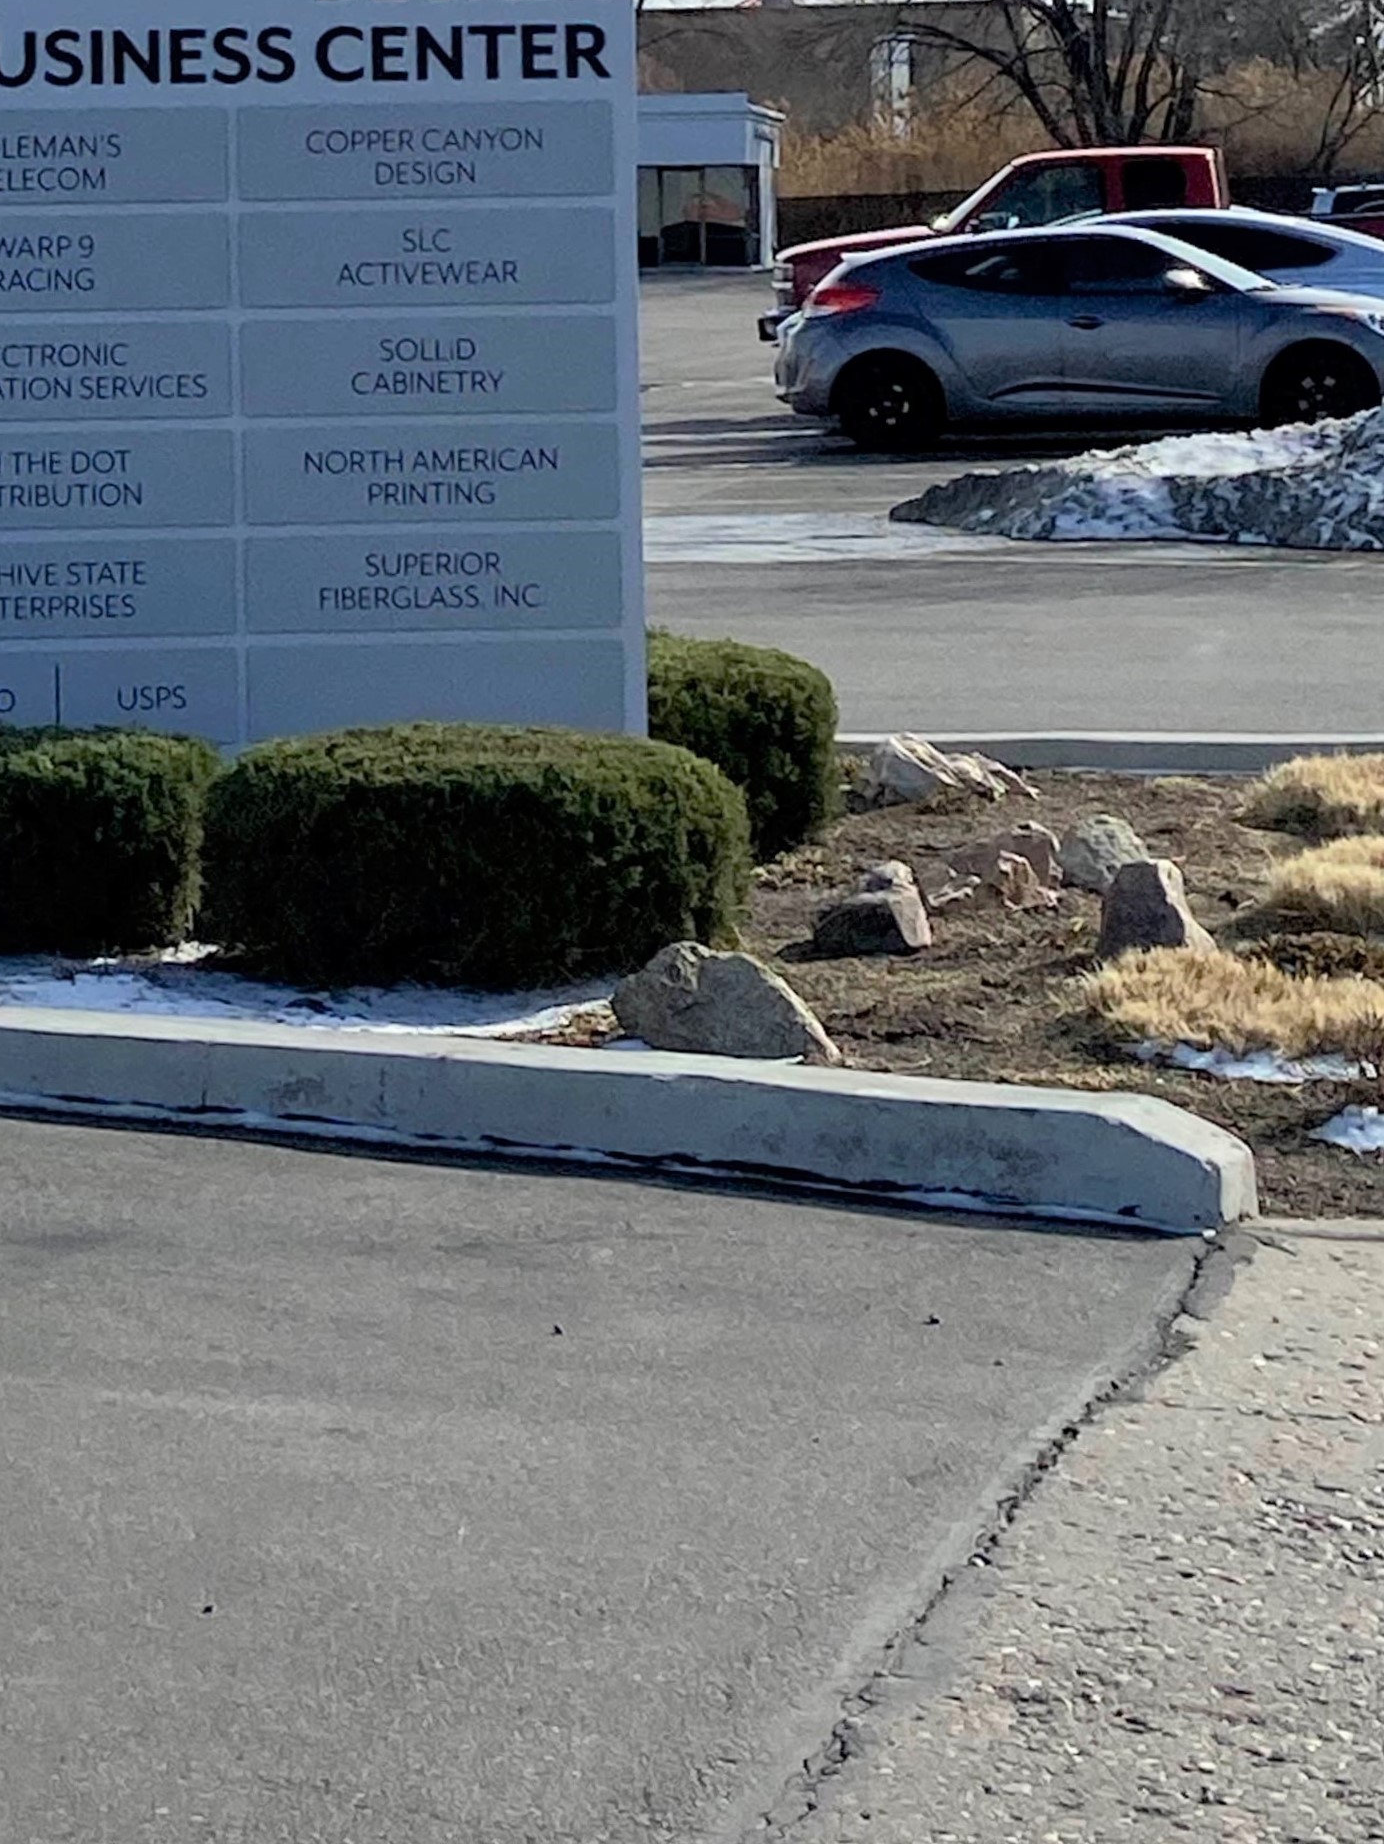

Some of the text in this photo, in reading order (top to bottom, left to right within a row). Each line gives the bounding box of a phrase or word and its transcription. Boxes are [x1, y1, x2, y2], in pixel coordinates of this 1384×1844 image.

[314, 23, 612, 83] CENTER
[305, 127, 543, 155] COPPER CANYON
[374, 160, 476, 186] DESIGN
[77, 234, 95, 259] 9
[402, 227, 452, 254] SLC
[337, 260, 519, 287] ACTIVEWEAR
[79, 373, 208, 401] SERVICES
[350, 369, 504, 396] CABINETRY
[8, 450, 63, 476] THE
[70, 449, 132, 475] DOT
[304, 447, 558, 475] NORTH AMERICAN
[367, 480, 496, 506] PRINTING
[65, 560, 147, 587] STATE
[364, 551, 502, 578] SUPERIOR
[116, 684, 187, 712] USPS
